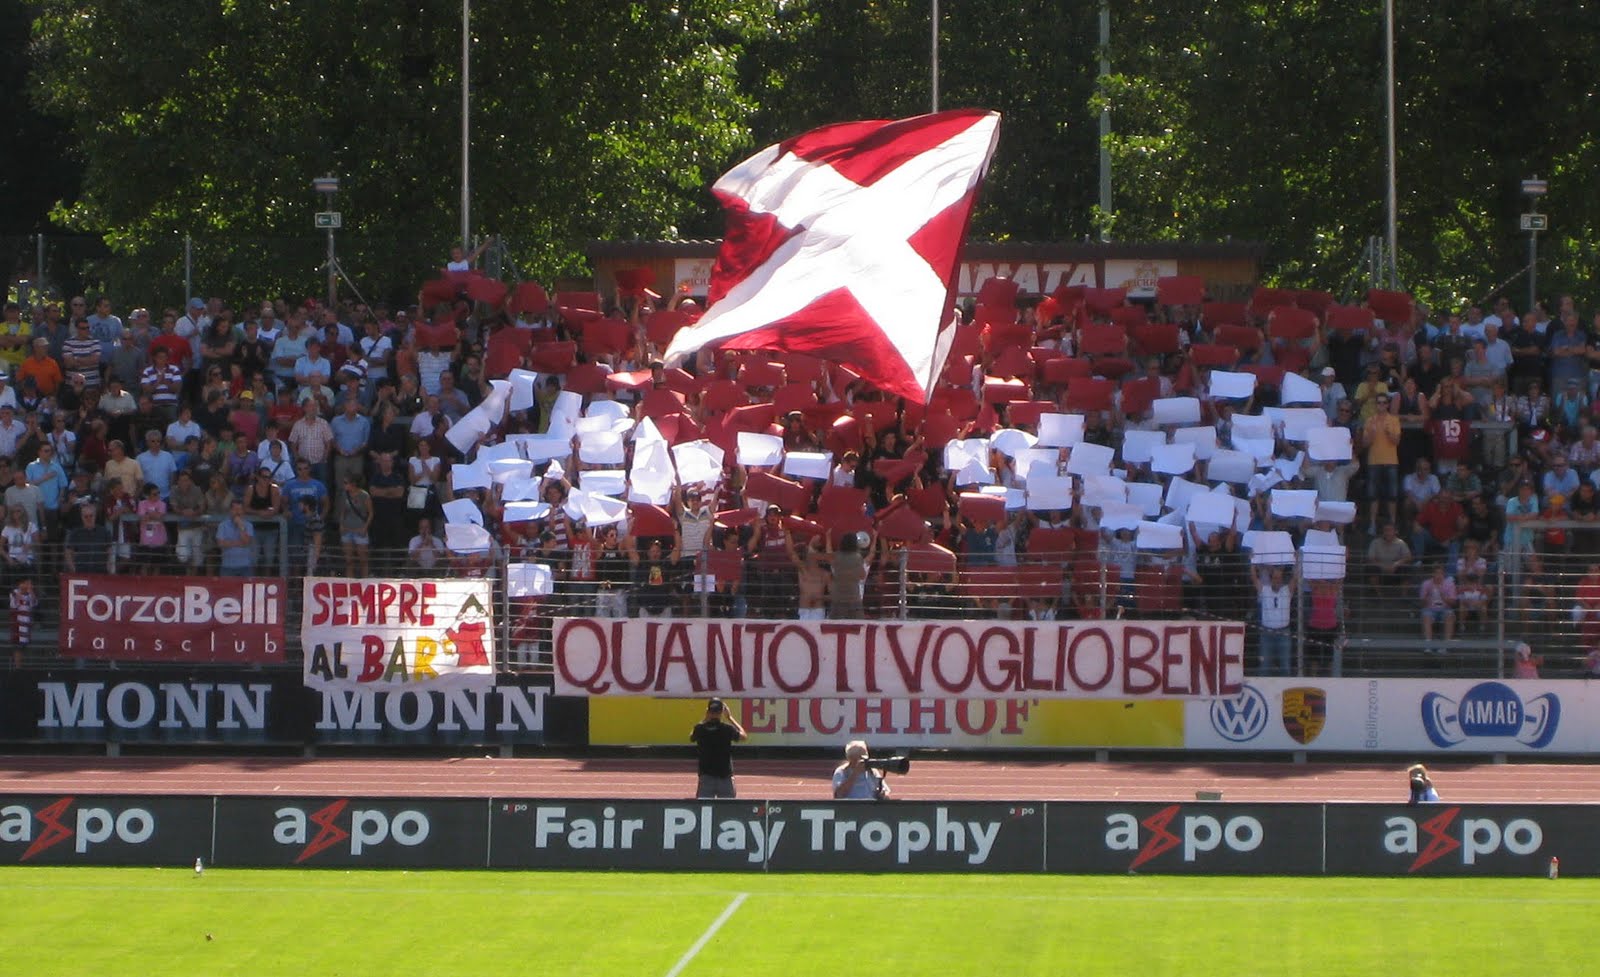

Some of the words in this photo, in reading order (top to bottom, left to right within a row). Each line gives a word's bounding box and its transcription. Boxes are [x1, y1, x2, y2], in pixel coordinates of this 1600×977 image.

[1442, 419, 1461, 437] 15
[67, 579, 278, 625] ForzaBelli
[311, 582, 437, 627] SEMPRE
[310, 641, 348, 682] AL
[357, 634, 439, 683] BAR
[37, 681, 272, 729] MONN
[314, 686, 551, 732] MONN
[741, 698, 1039, 735] EICHHOF
[1464, 700, 1518, 725] AMAG
[535, 806, 644, 850] Fair
[662, 806, 786, 863] Play
[800, 807, 1002, 865] Trophy
